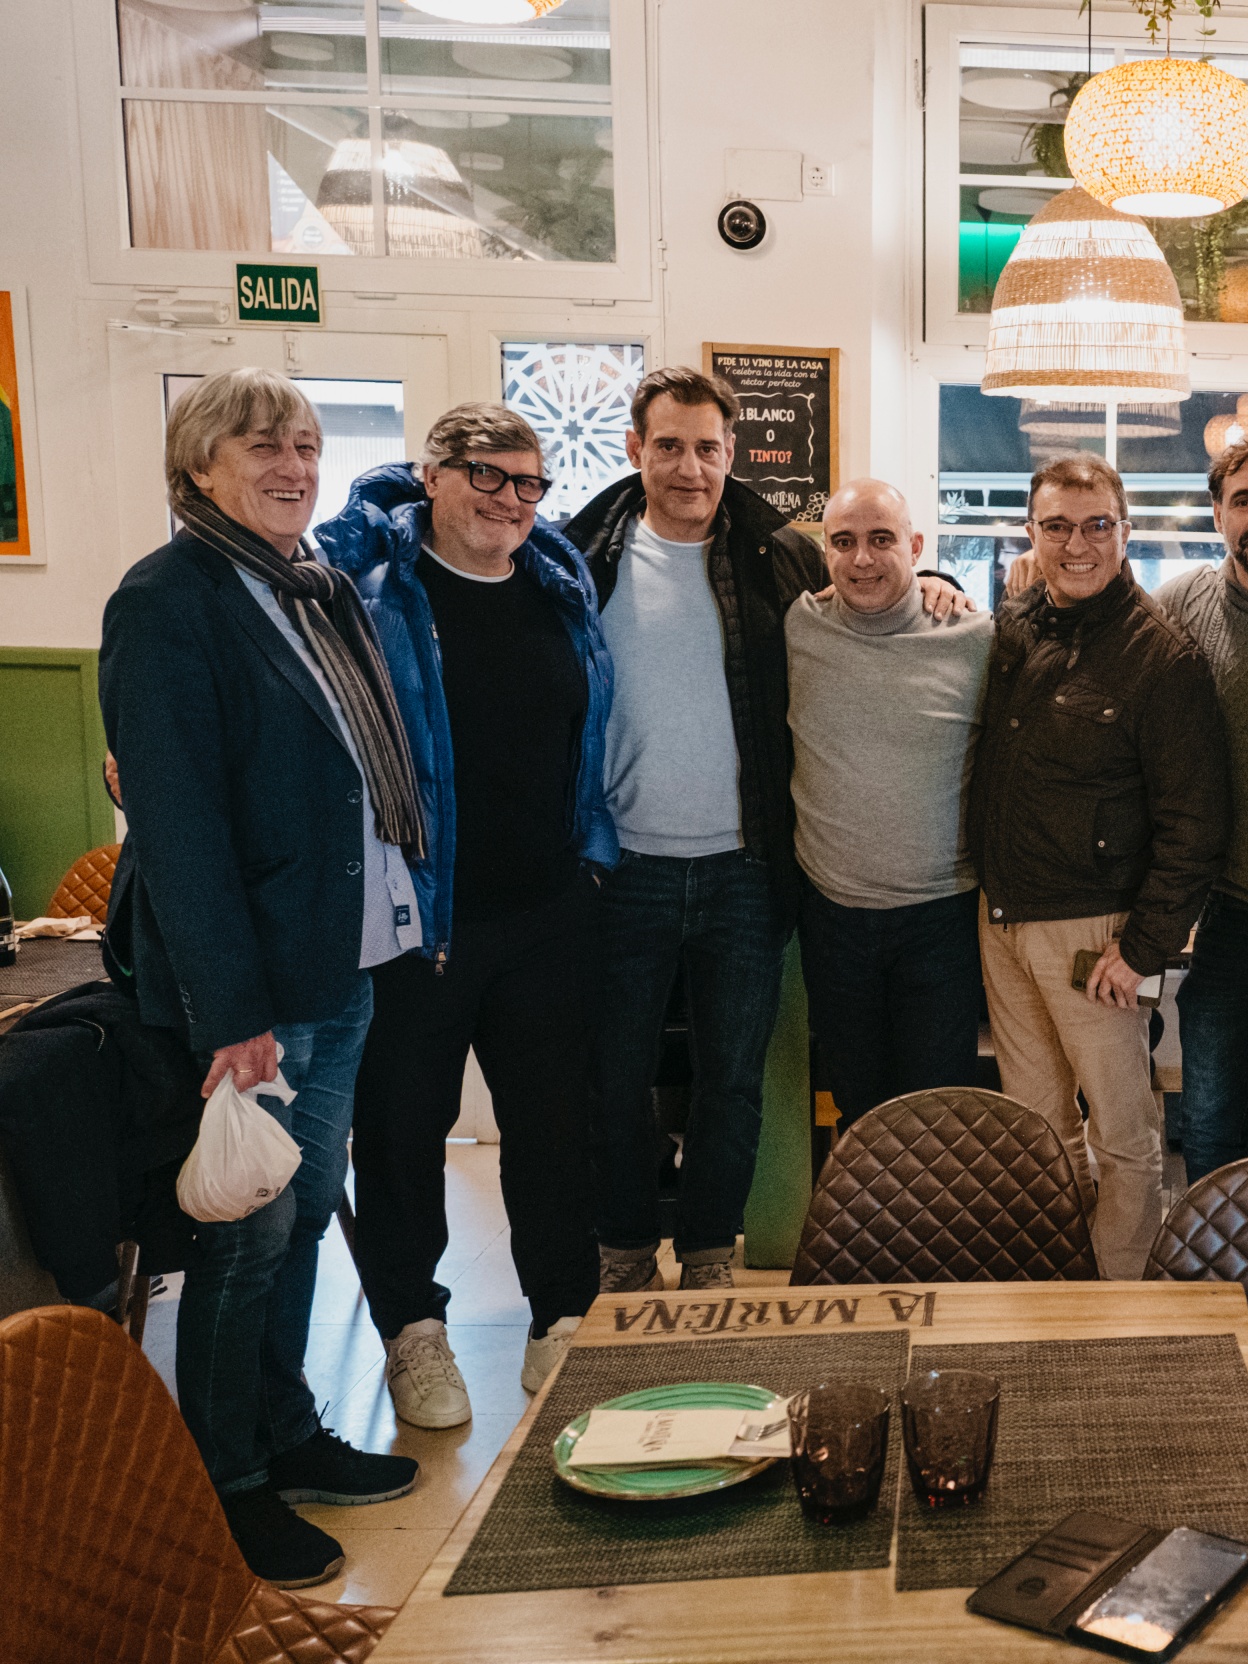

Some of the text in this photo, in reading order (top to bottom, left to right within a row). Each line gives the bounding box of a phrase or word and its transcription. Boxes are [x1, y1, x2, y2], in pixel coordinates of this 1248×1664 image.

[240, 275, 317, 311] SALIDA
[717, 357, 823, 370] PIDE TU VINO DE LA CASA
[725, 366, 731, 375] Y
[732, 367, 762, 376] celebra
[763, 368, 773, 377] la
[774, 368, 792, 378] vida
[809, 370, 818, 379] el
[740, 377, 802, 389] néctar perfecto
[738, 408, 795, 422] ¿BLANCO
[766, 429, 775, 443] O
[749, 449, 793, 464] TINTO?
[613, 1290, 938, 1336] LA MARTEÑA
